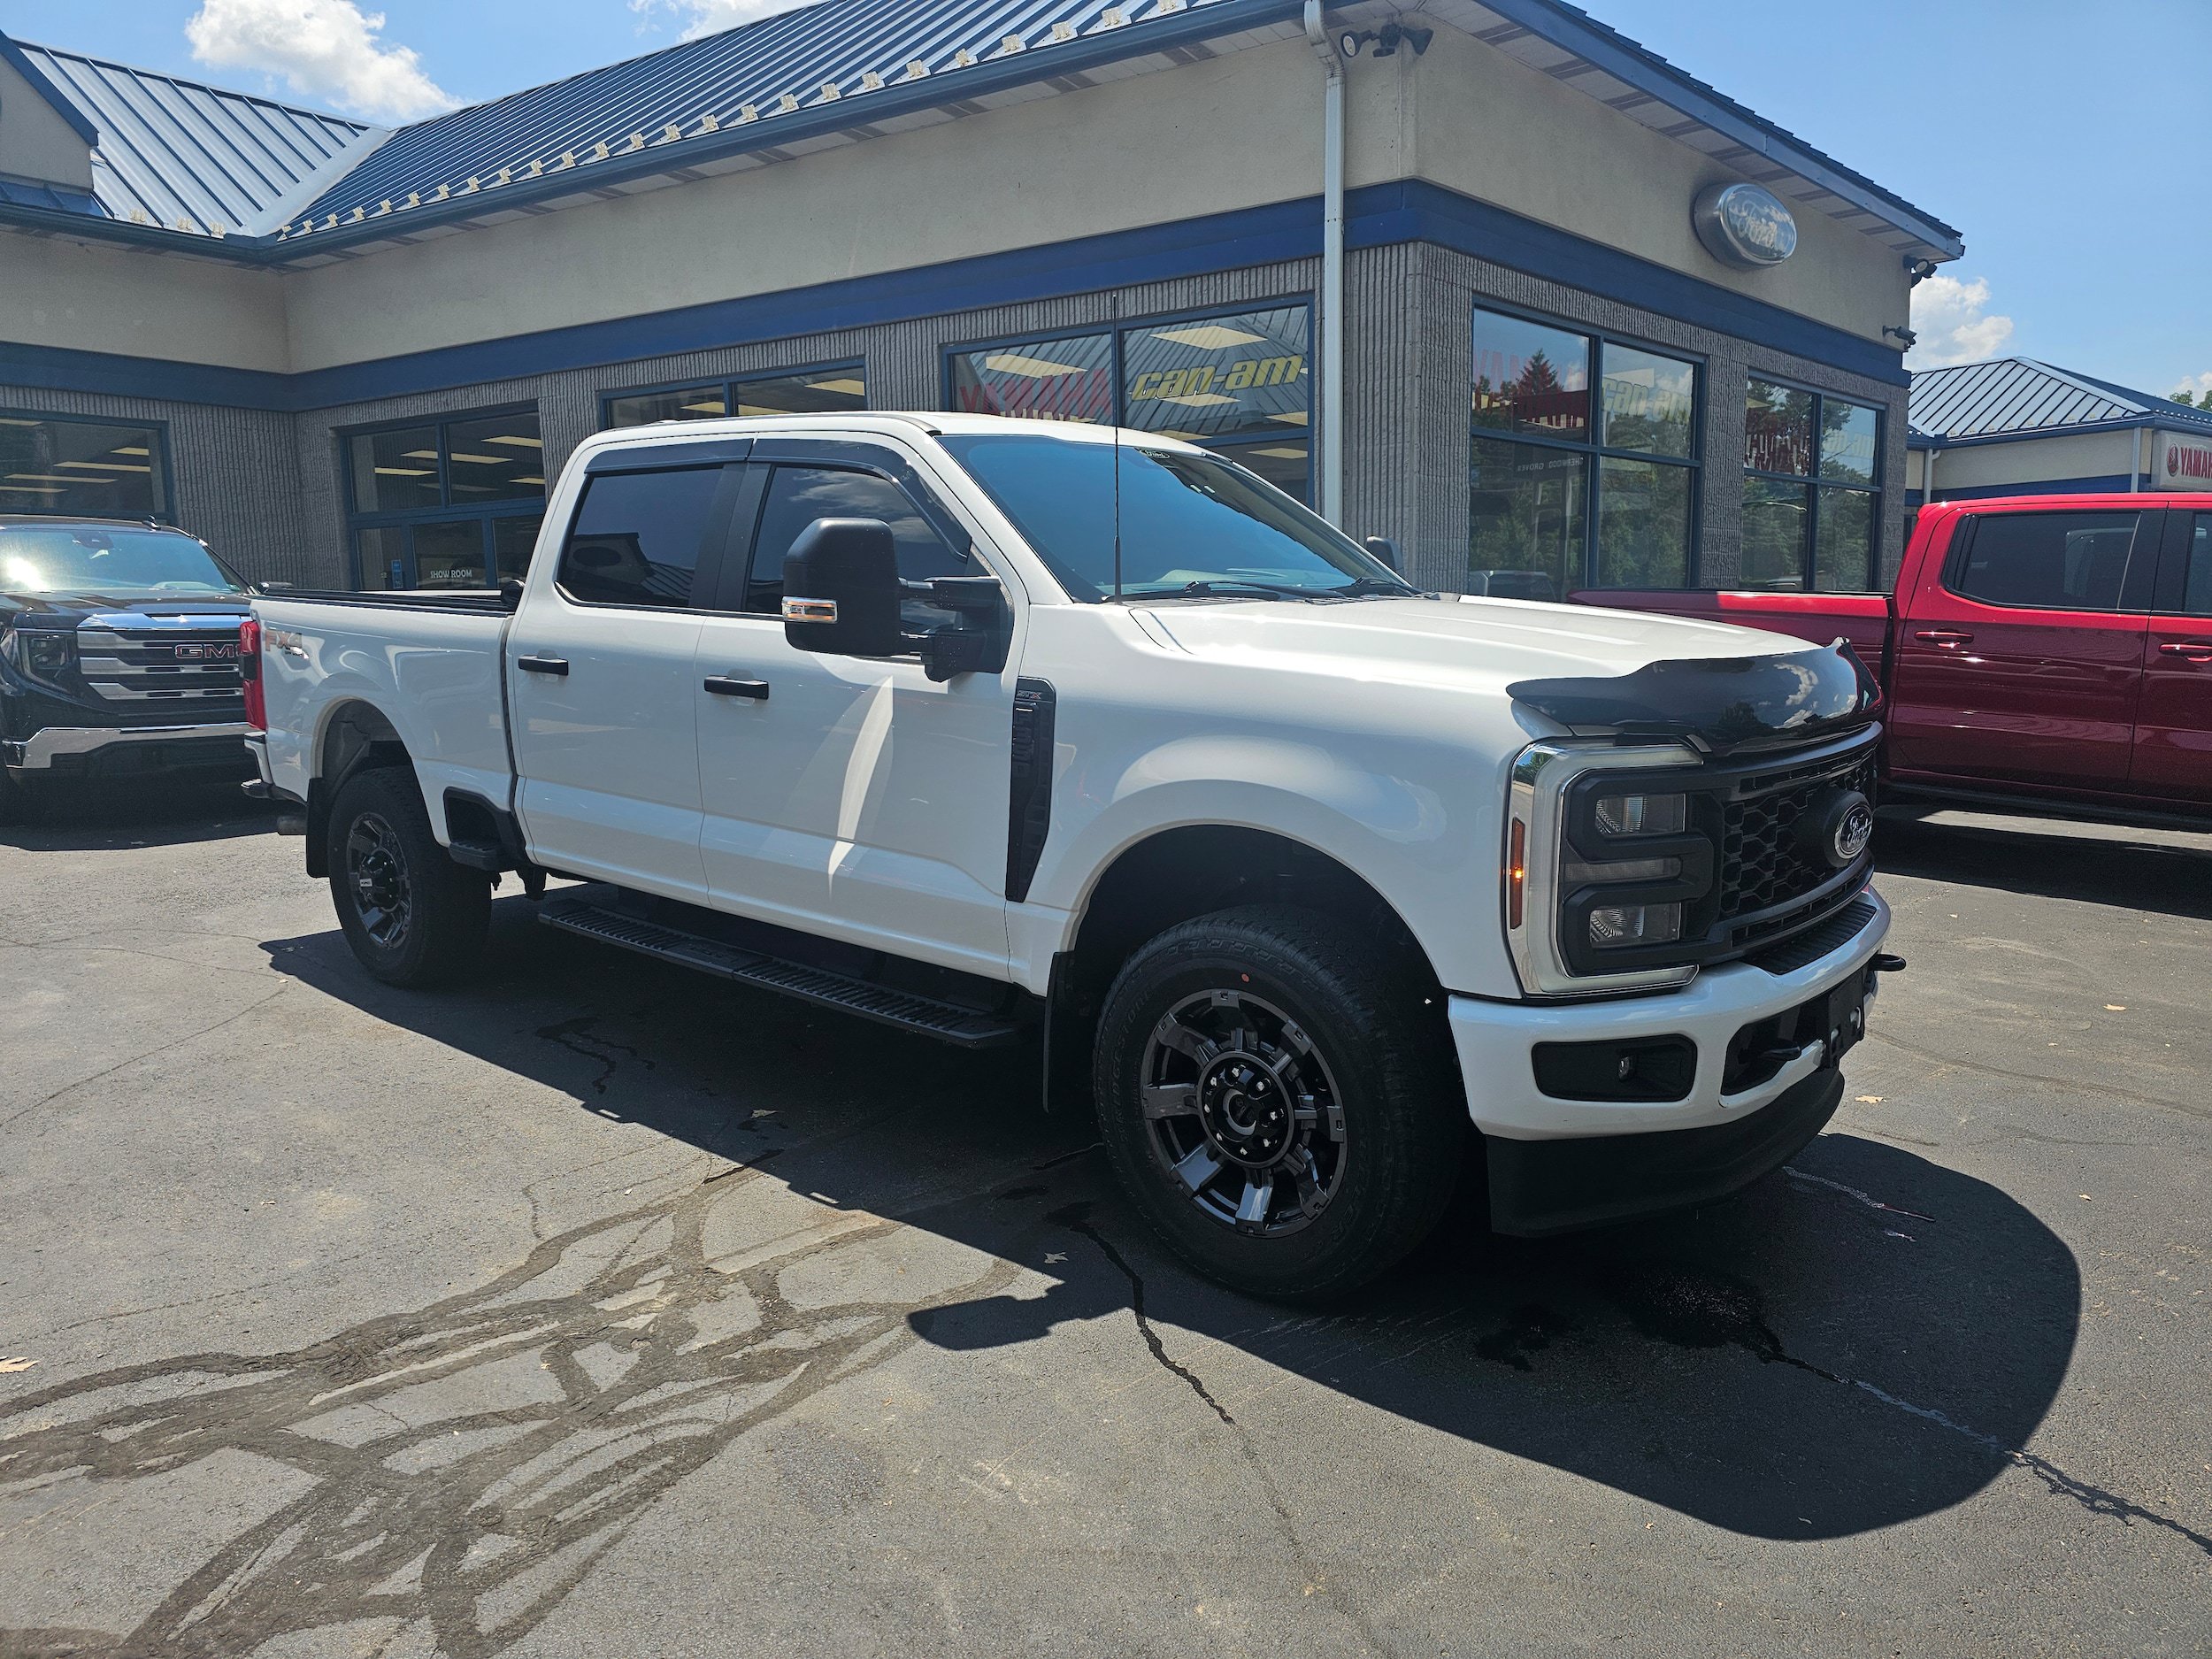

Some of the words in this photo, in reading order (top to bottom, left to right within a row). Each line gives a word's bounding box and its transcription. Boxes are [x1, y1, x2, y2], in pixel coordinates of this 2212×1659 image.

[1132, 355, 1303, 401] can-am
[430, 570, 449, 579] SHOW
[451, 569, 472, 578] ROOM
[175, 643, 242, 659] GM
[265, 630, 303, 651] FX4
[1847, 814, 1871, 849] Ford
